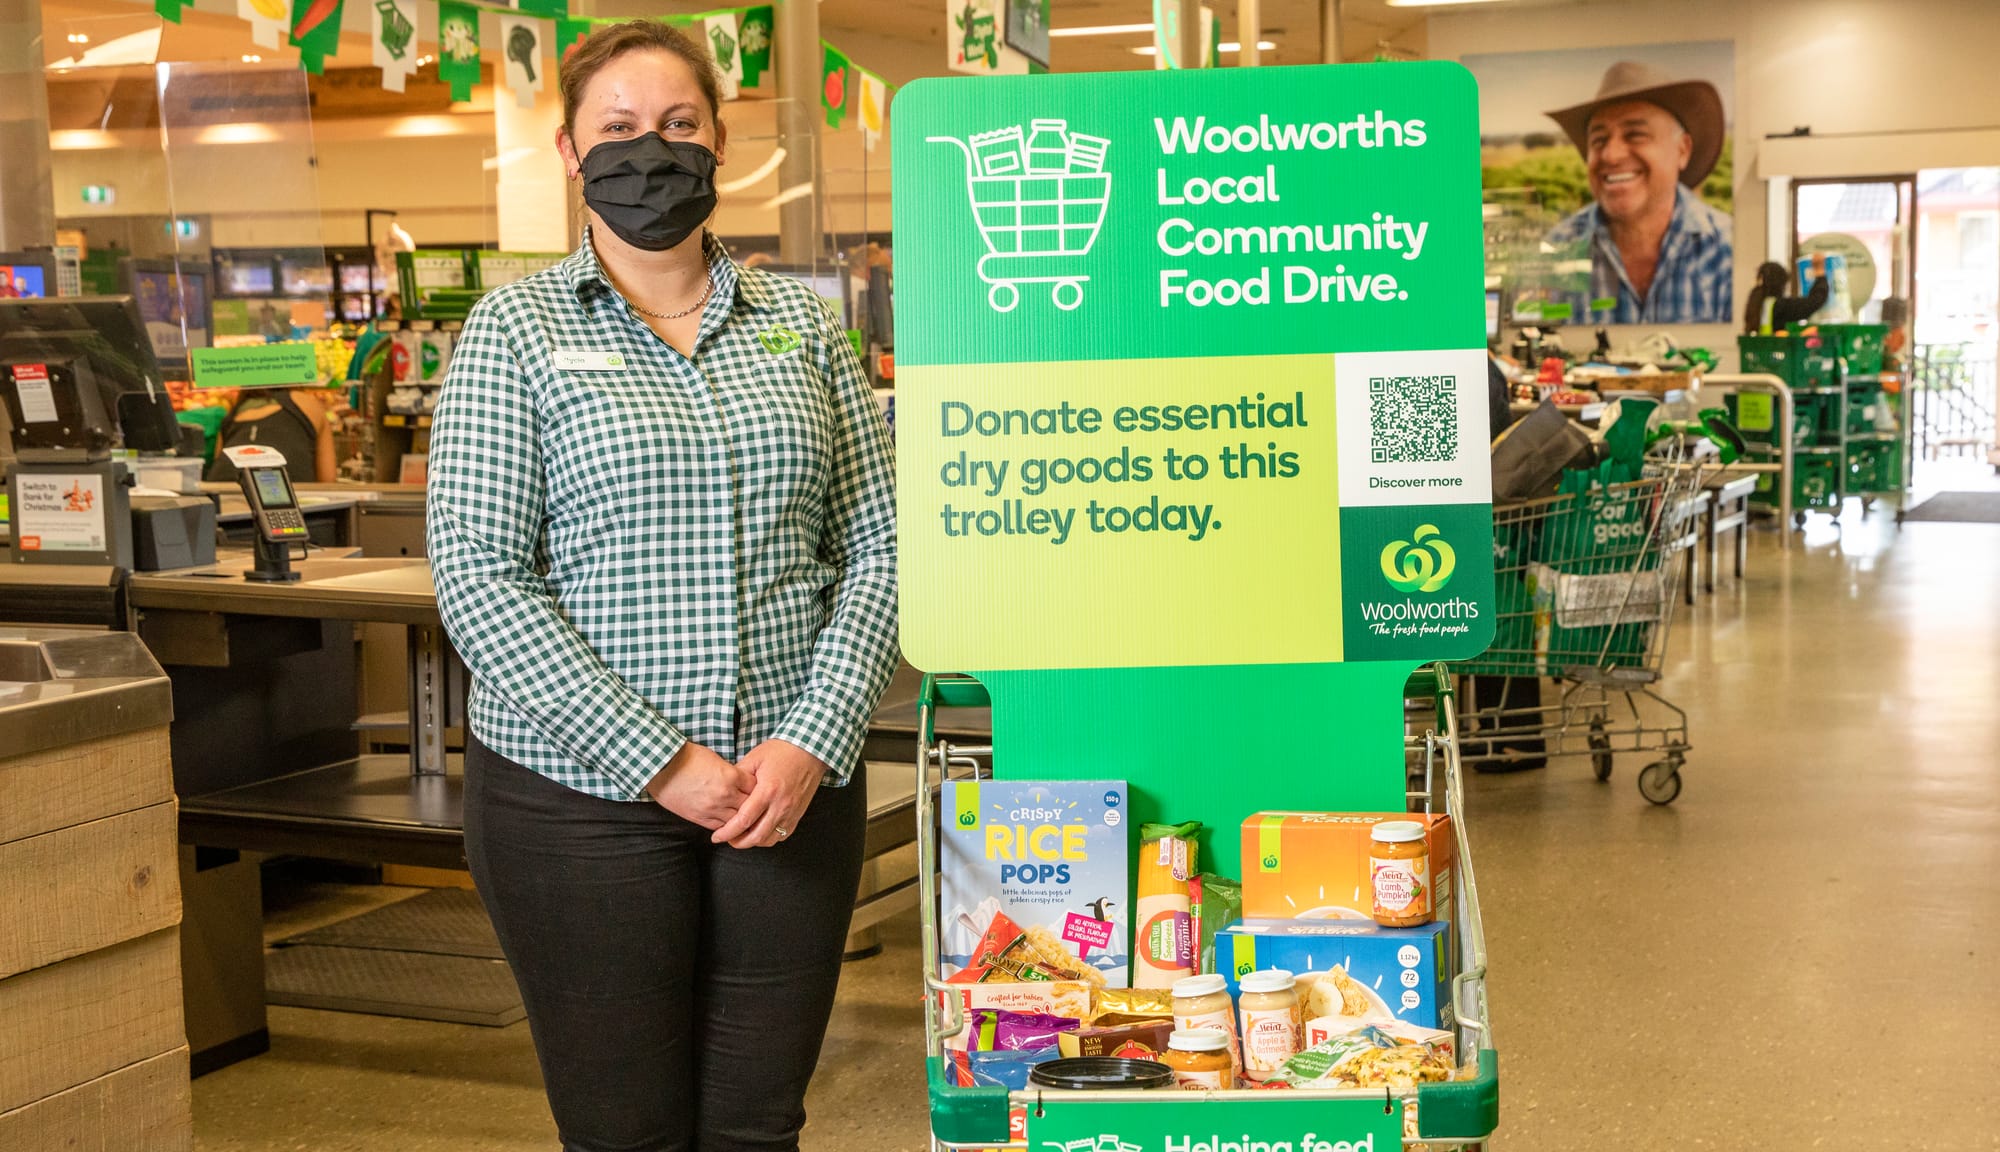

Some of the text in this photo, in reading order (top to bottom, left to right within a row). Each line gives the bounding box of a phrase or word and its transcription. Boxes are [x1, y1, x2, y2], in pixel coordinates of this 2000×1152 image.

[1154, 110, 1426, 154] Woolworths
[1158, 165, 1279, 205] Local
[1157, 212, 1428, 260] Community
[1160, 265, 1408, 306] Food Drive.
[941, 391, 1308, 437] Donate essential
[940, 442, 1300, 497] dry goods to this
[1369, 477, 1463, 489] Discover more
[24, 503, 61, 511] Christmas
[940, 496, 1222, 545] trolley today.
[1360, 597, 1479, 621] Woolworths
[1369, 621, 1469, 639] The fresh food people
[1010, 808, 1063, 822] CRISPY
[985, 825, 1088, 861] RICE
[1001, 864, 1071, 884] POPS
[1020, 888, 1047, 896] delicious
[1048, 889, 1064, 897] pops
[1378, 890, 1410, 900] Pumpkin
[1381, 883, 1404, 892] Lamb,
[1181, 918, 1191, 960] Organic
[1404, 972, 1416, 980] 72
[987, 993, 1043, 1003] Crafted for babies
[1084, 1037, 1101, 1045] NEW
[1258, 1037, 1279, 1046] Apple
